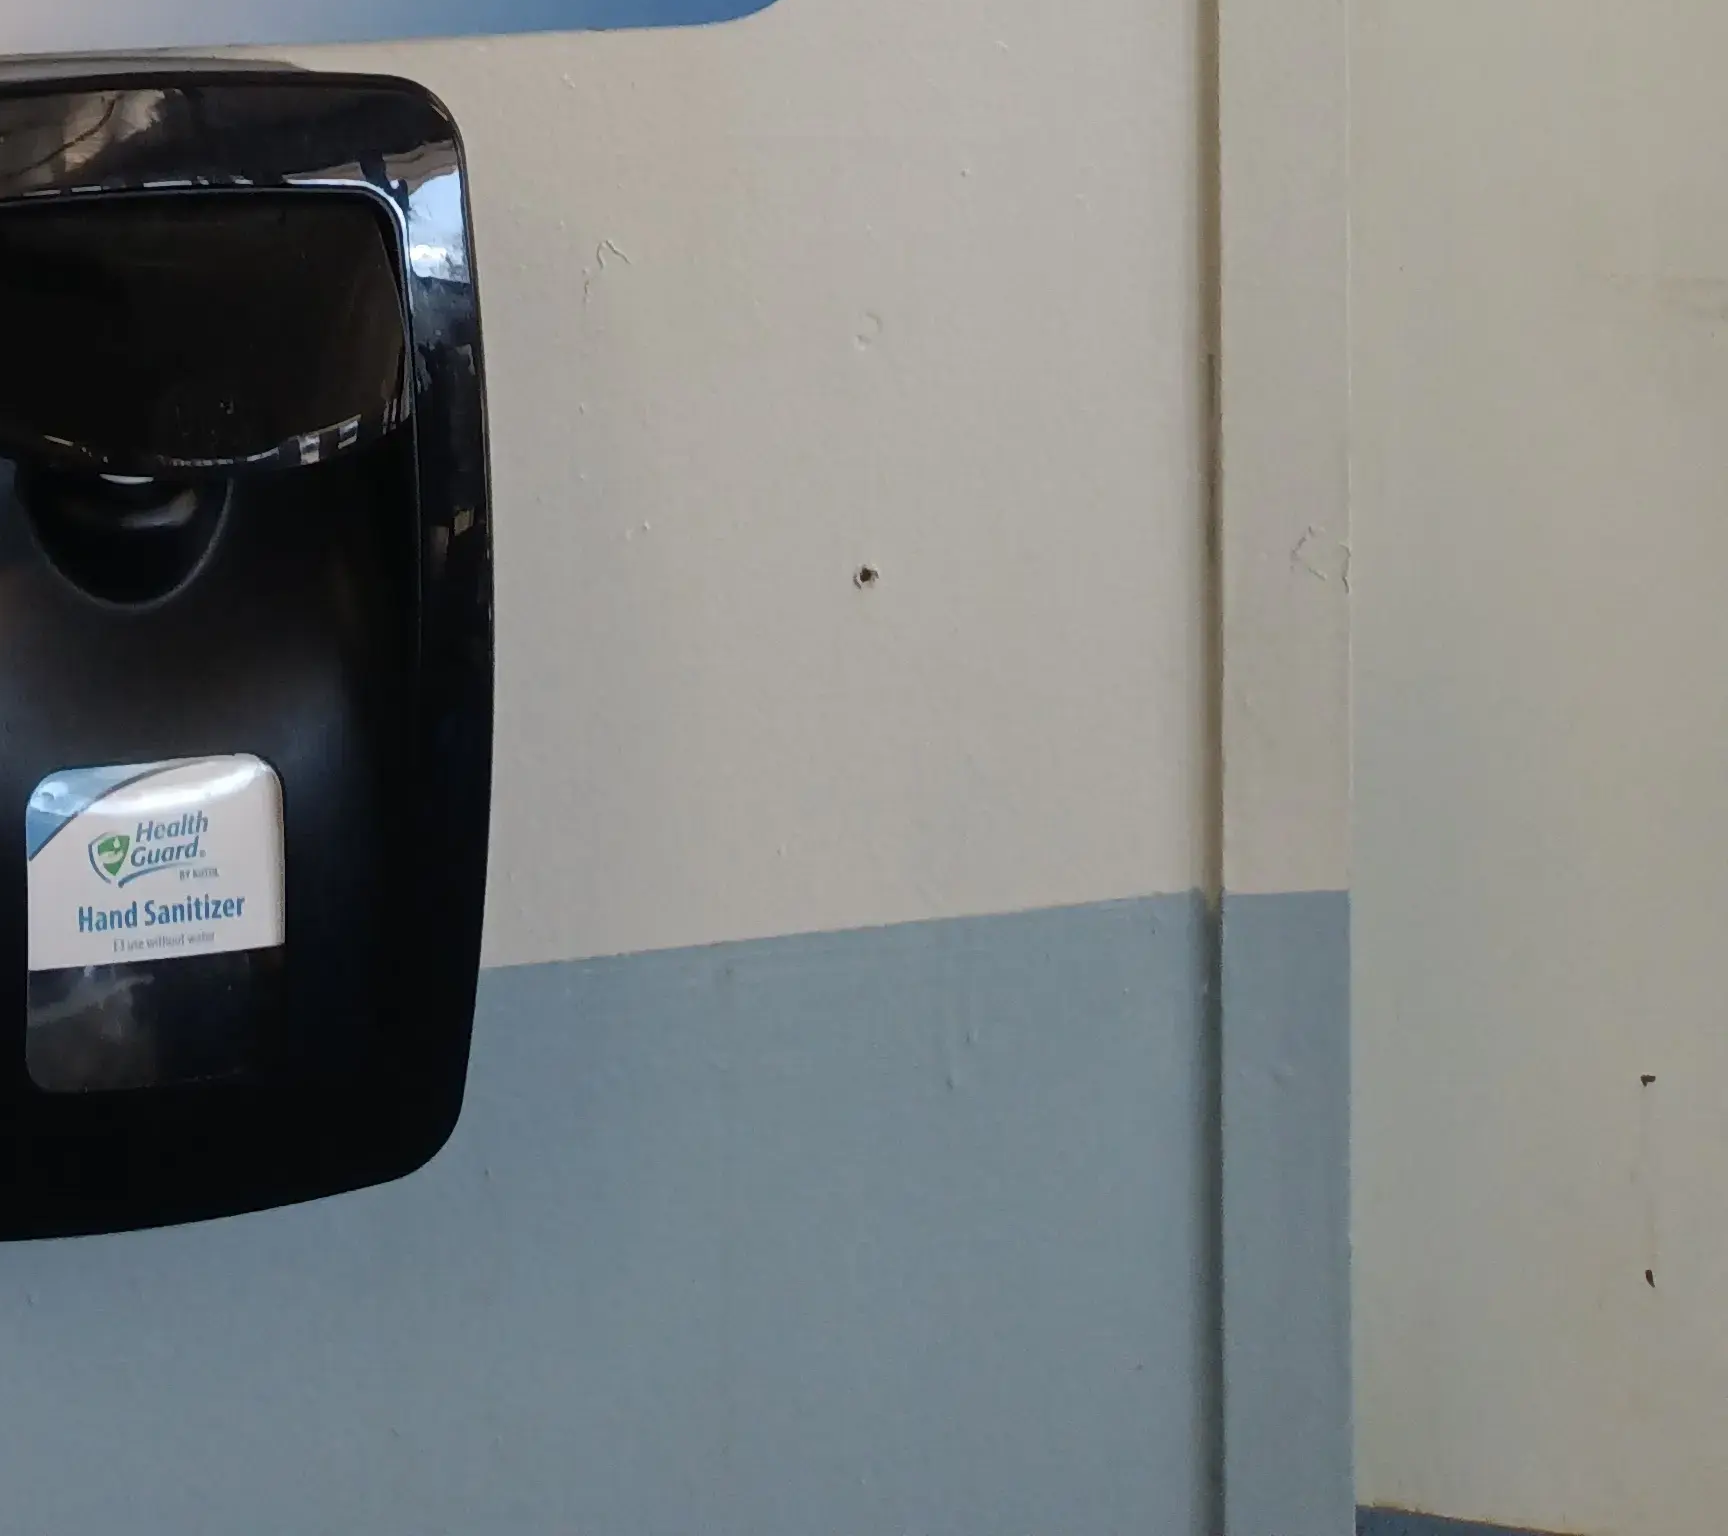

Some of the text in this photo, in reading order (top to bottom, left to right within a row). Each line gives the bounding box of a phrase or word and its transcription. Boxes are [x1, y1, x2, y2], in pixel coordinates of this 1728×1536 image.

[136, 811, 208, 842] Health
[131, 835, 199, 867] Guard
[79, 894, 245, 932] Hand Sanitizer
